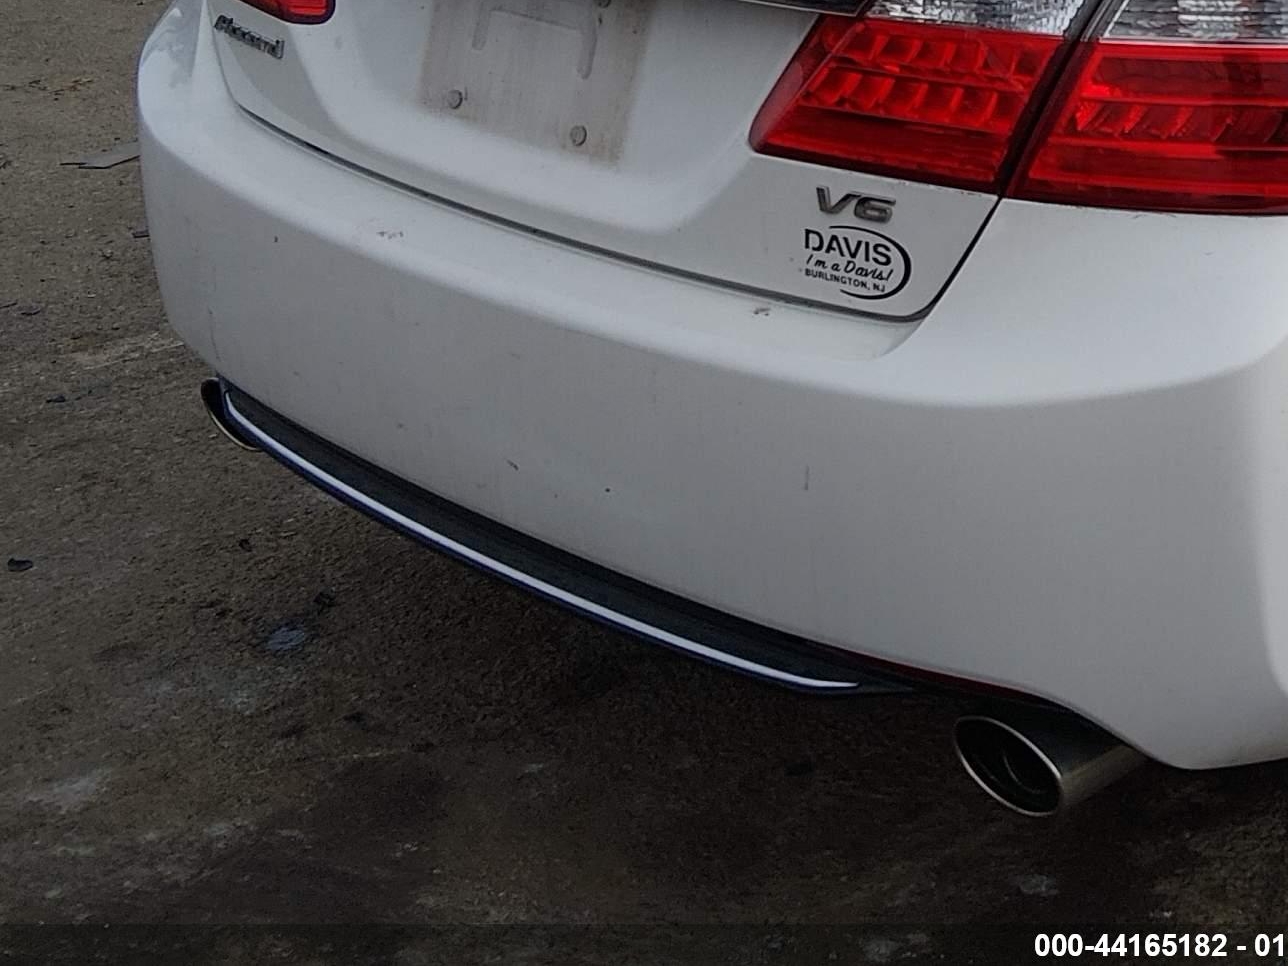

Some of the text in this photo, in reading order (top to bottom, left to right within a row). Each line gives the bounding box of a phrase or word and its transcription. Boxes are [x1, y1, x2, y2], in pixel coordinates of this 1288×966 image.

[815, 185, 897, 224] V6
[804, 228, 892, 266] DAVIS
[806, 254, 828, 269] Im
[831, 263, 841, 272] a
[804, 268, 886, 293] BURLINGTON, NJ
